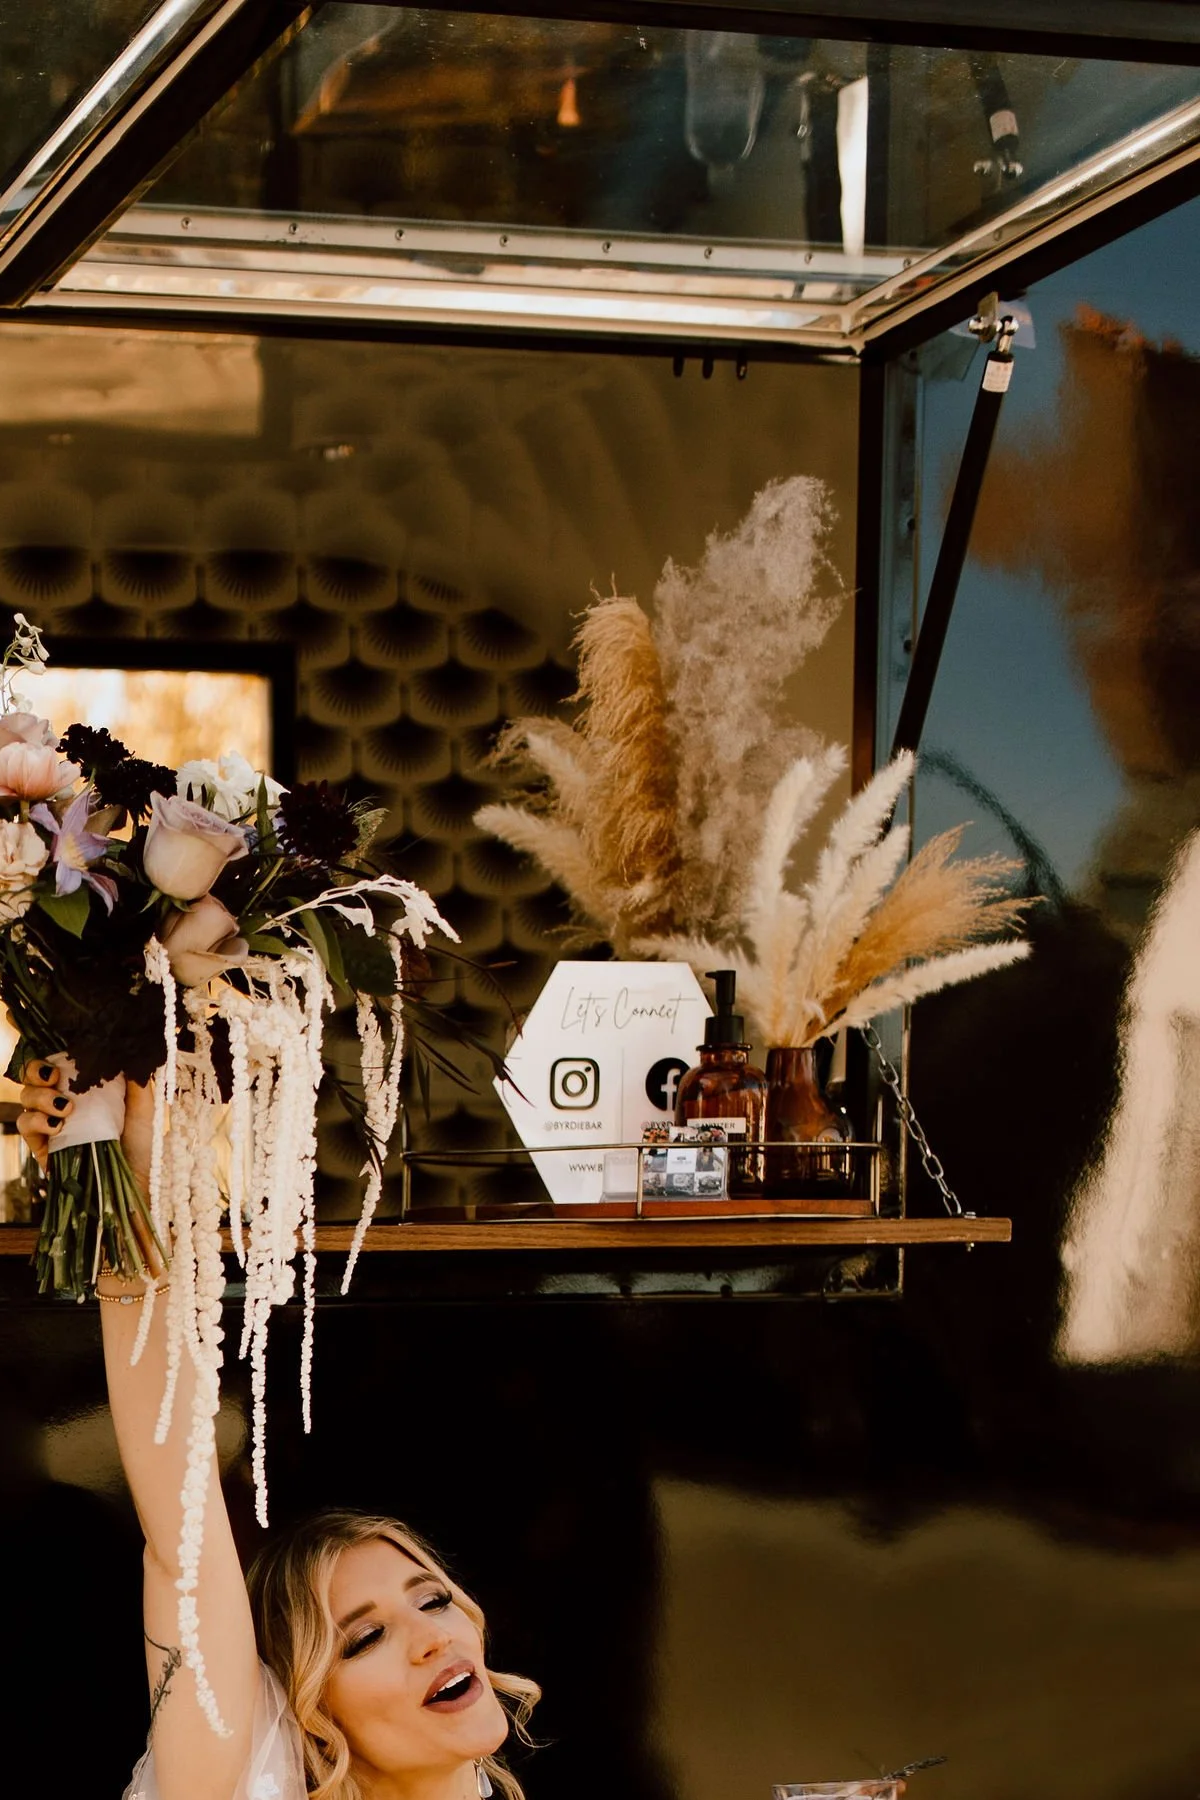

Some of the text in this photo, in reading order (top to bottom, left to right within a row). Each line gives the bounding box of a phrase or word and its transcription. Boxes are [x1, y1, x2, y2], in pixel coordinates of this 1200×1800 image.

[560, 986, 698, 1035] Let's Connect
[568, 1162, 604, 1173] WWW.B
